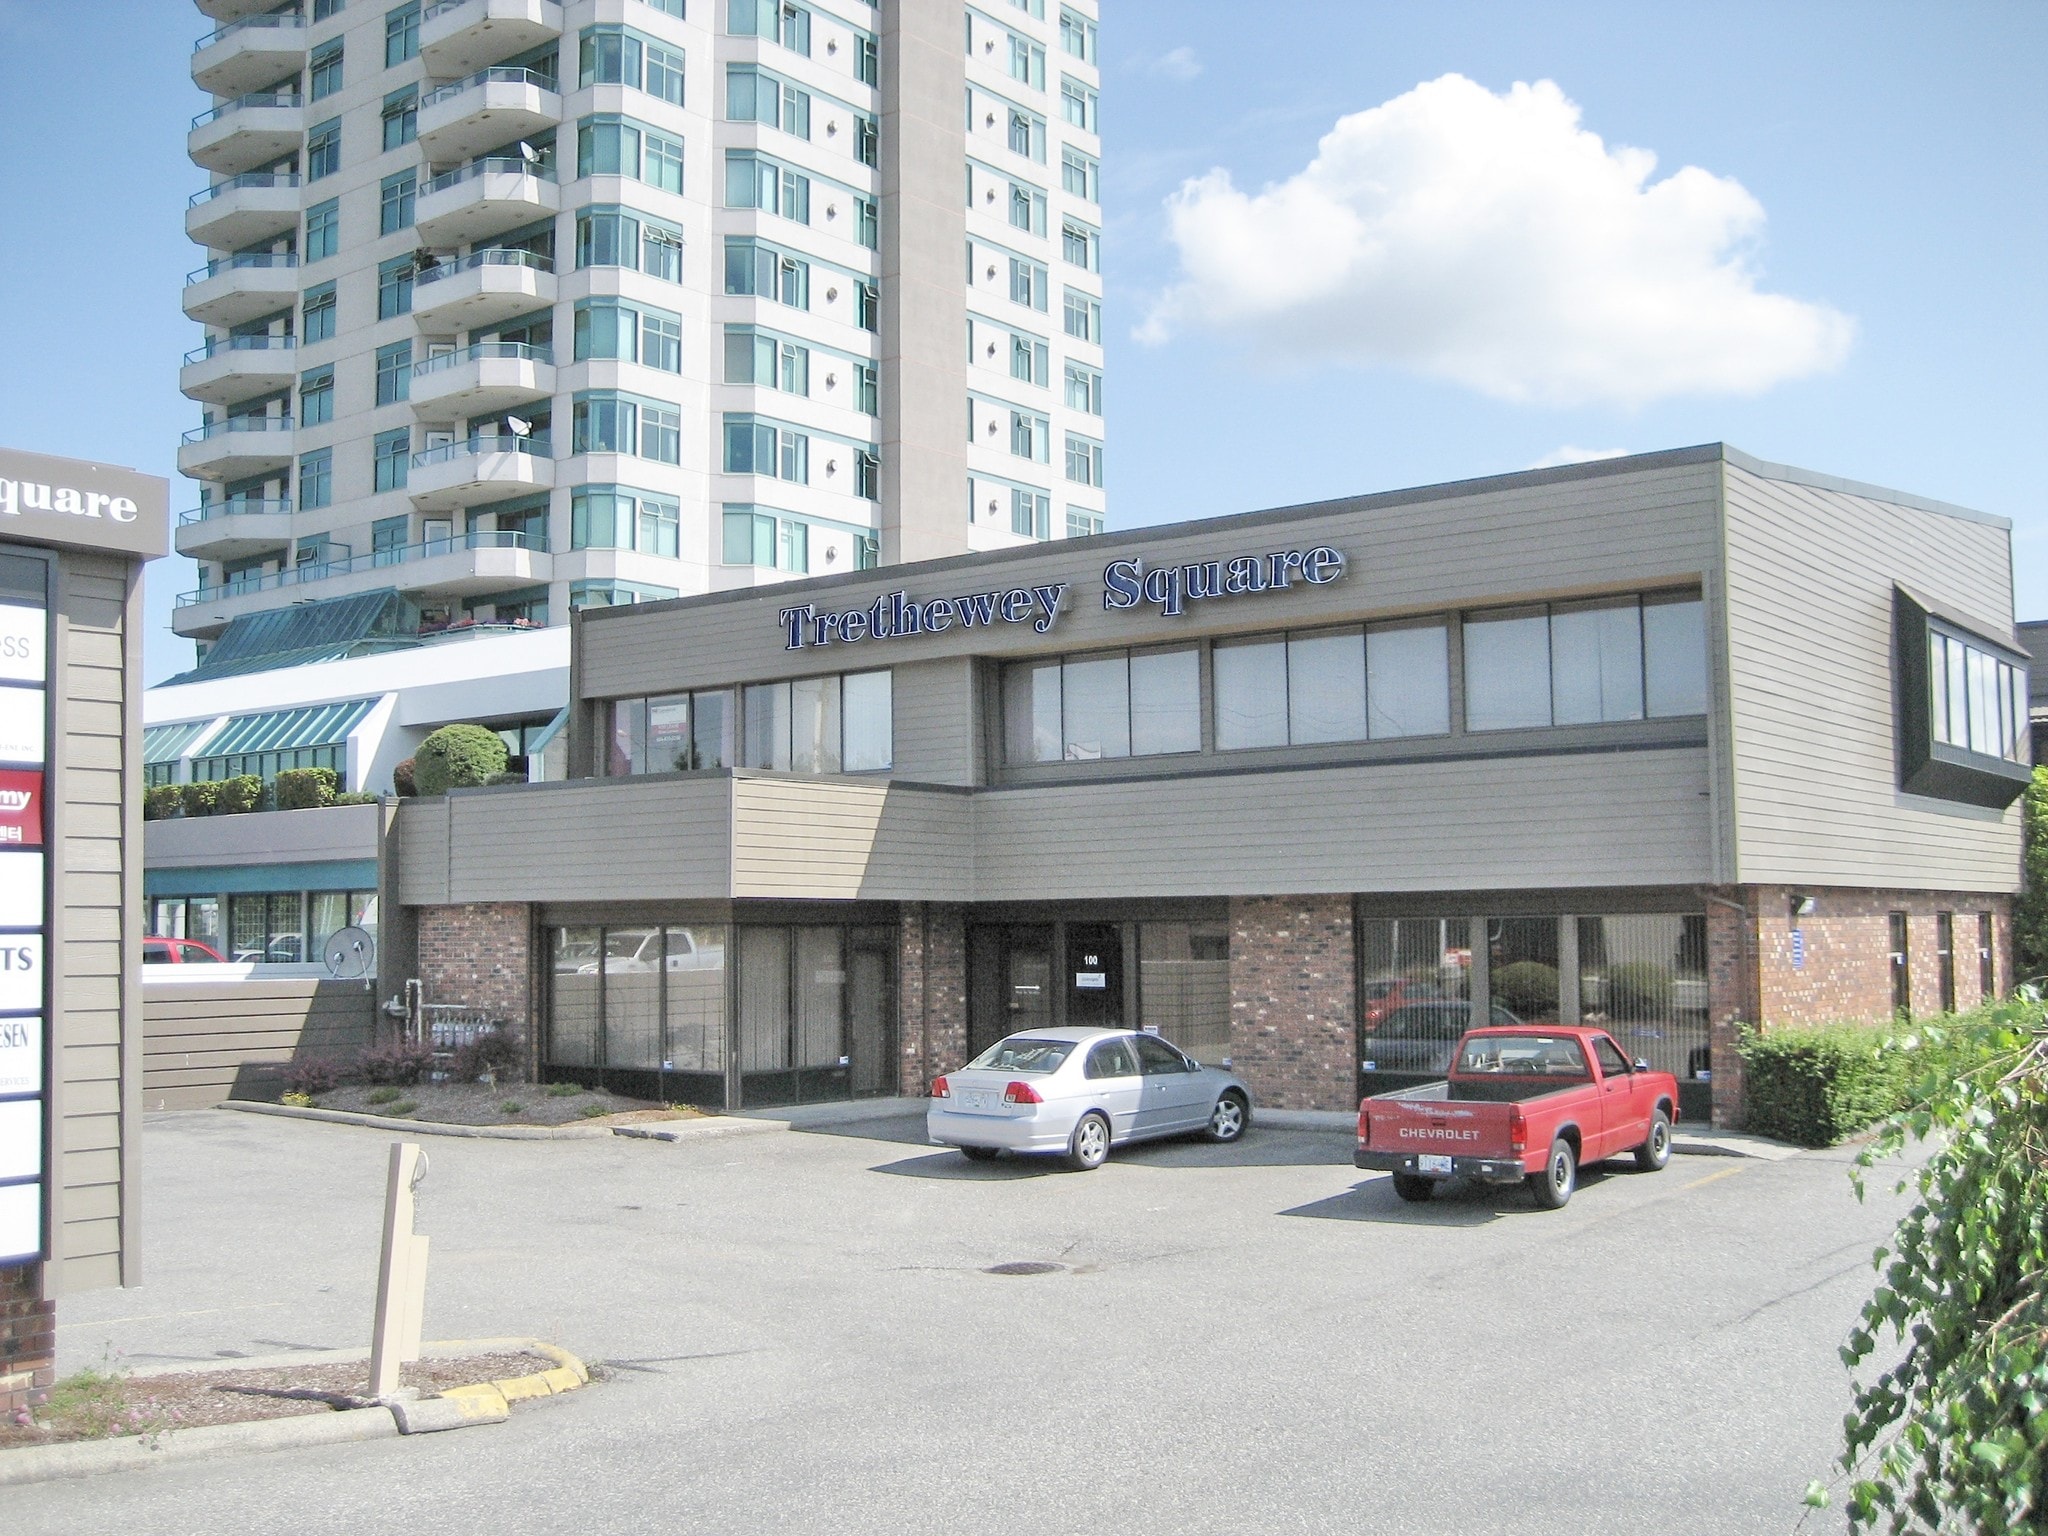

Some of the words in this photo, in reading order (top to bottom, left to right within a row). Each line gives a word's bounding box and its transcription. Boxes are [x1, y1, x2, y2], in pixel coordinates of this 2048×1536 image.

[779, 583, 1067, 650] Trethewey
[1103, 545, 1344, 616] Square
[0, 635, 30, 659] SS
[1084, 955, 1098, 965] 100
[1400, 1127, 1480, 1141] CHEVROLET
